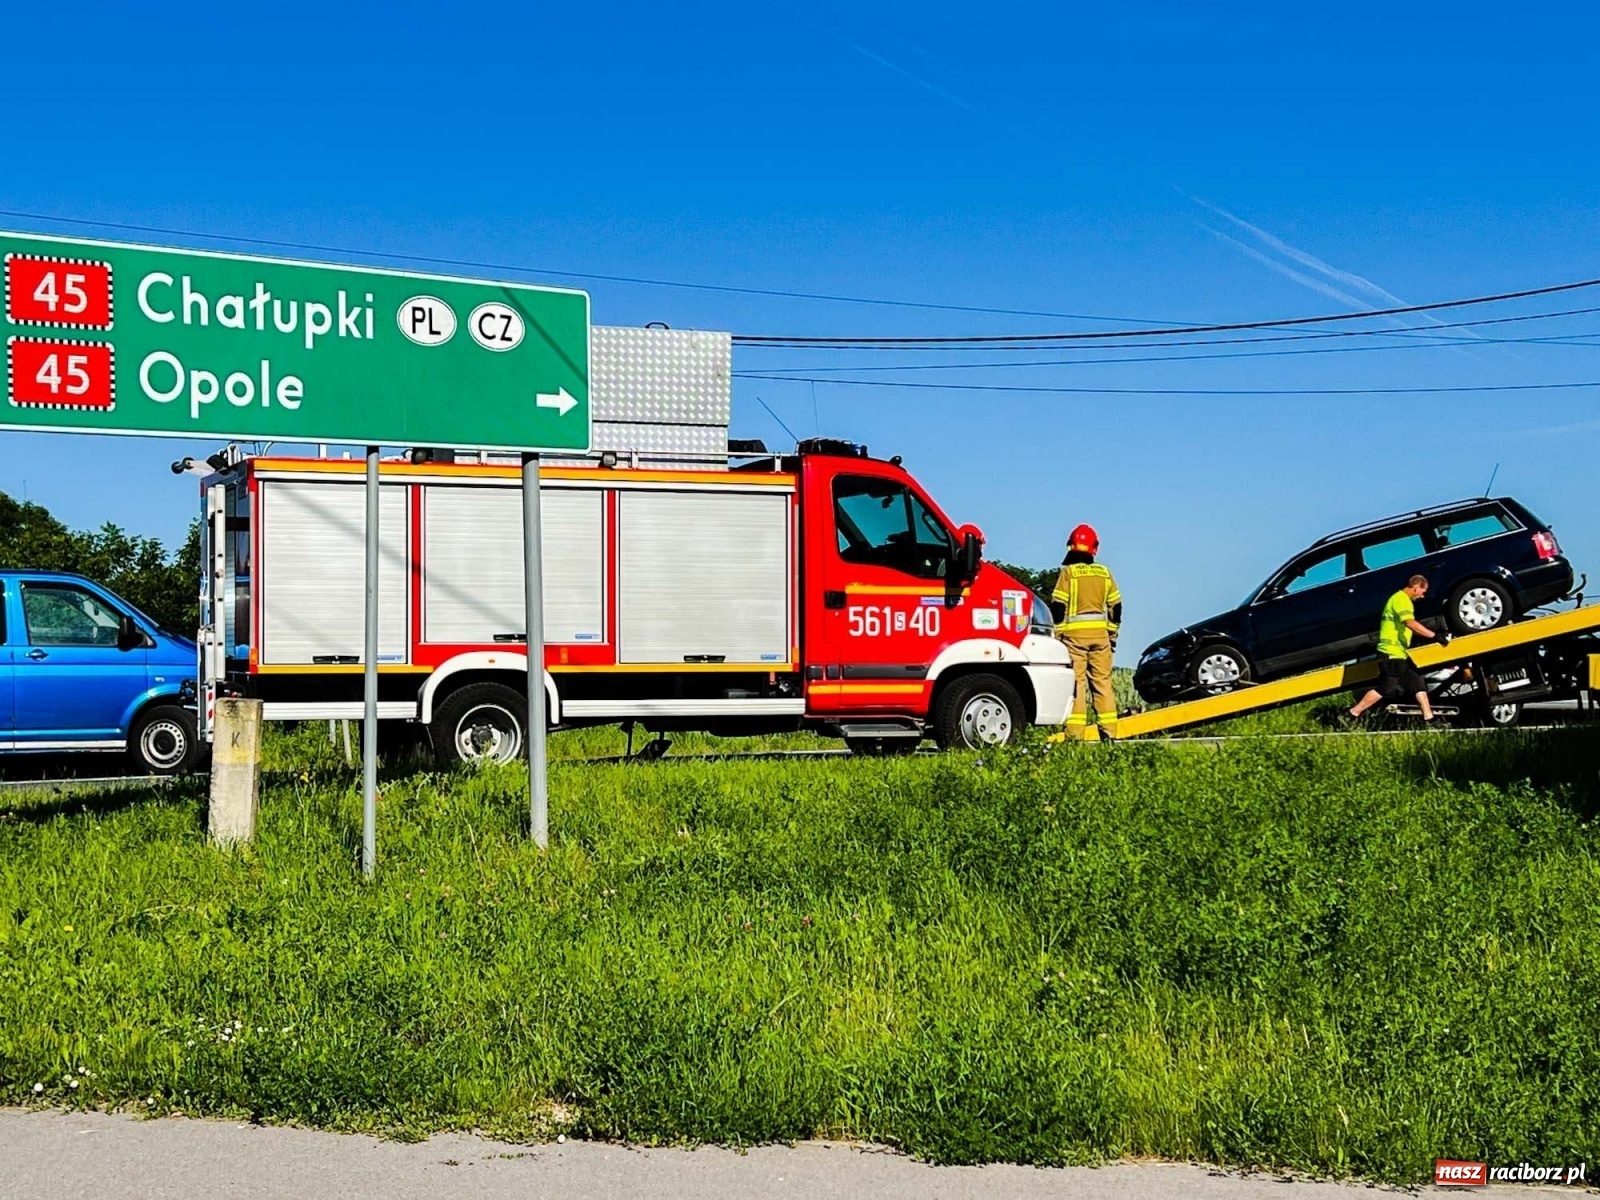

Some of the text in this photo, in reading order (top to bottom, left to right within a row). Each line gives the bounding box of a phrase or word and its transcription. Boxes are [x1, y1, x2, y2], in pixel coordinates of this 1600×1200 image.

[33, 271, 513, 349] 45 Chałupki PL CZ
[36, 351, 304, 419] 45 Opole
[848, 605, 892, 637] 561
[909, 605, 940, 637] 40
